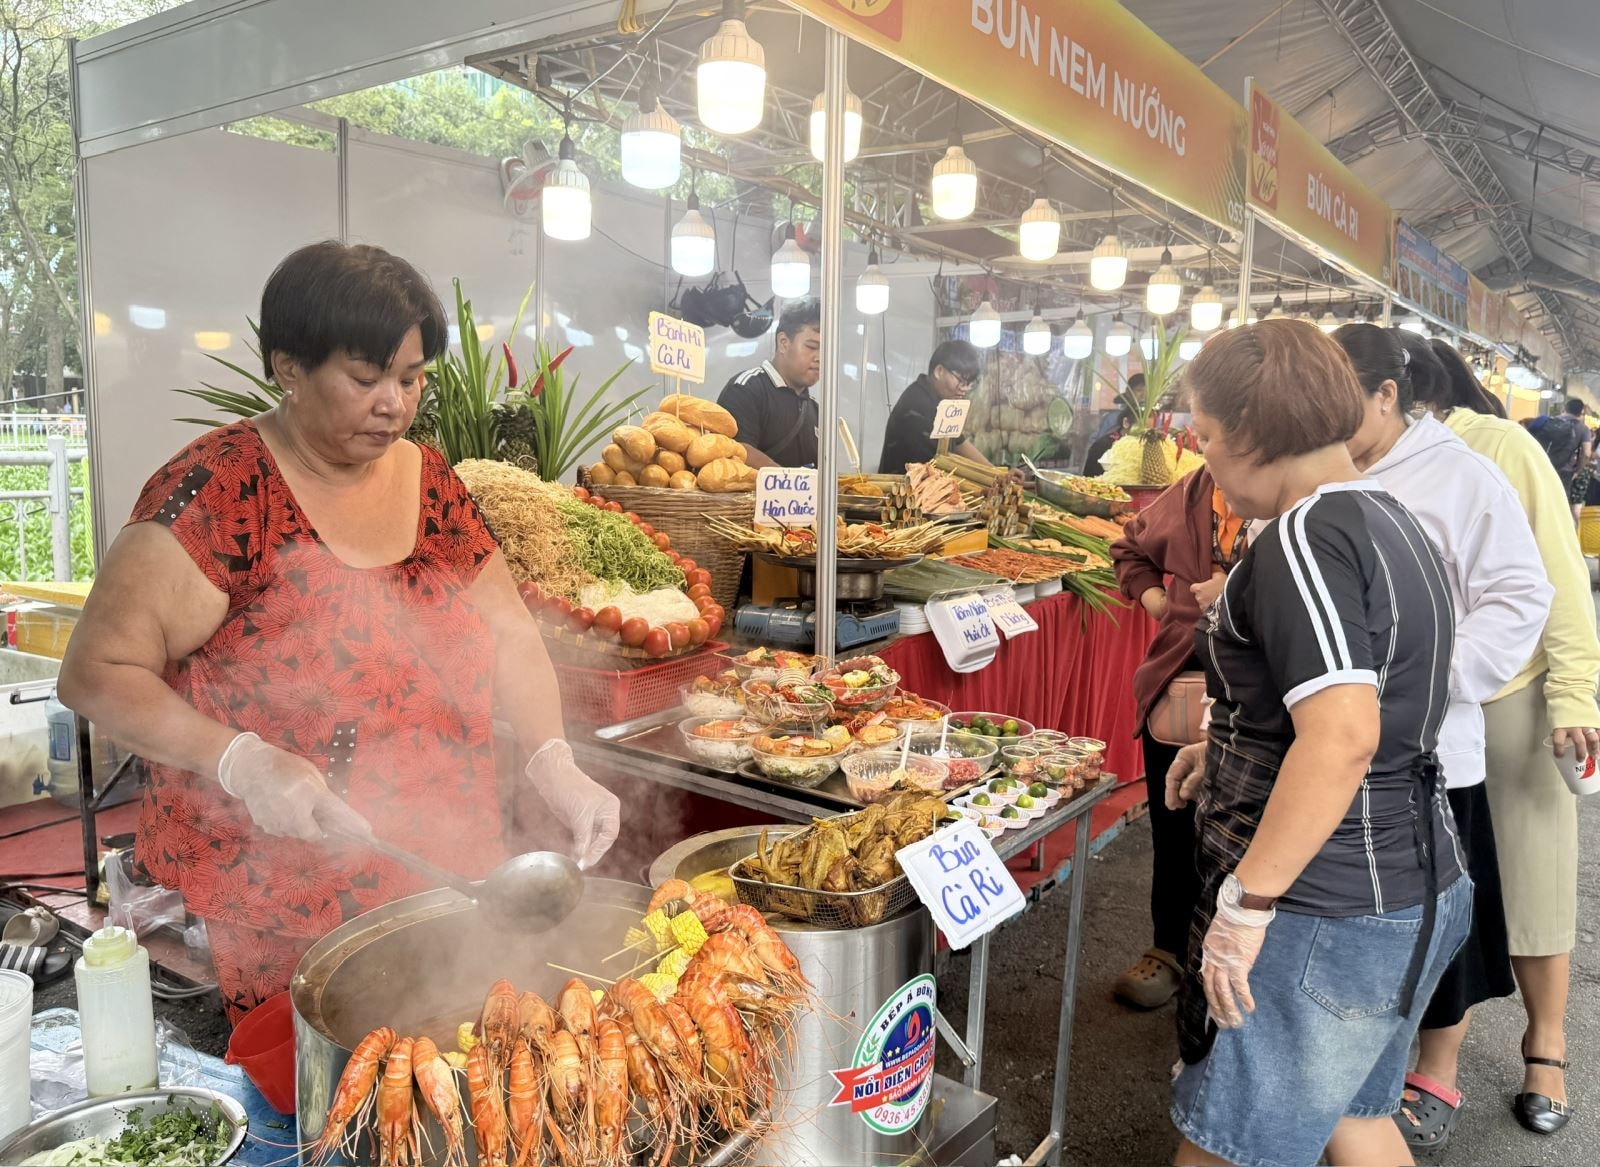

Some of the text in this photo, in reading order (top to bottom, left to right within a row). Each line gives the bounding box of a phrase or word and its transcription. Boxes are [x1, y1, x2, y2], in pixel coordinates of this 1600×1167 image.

[1048, 27, 1105, 108] NEM
[1113, 71, 1186, 156] NƯỚNG
[1307, 173, 1332, 222] BÚN
[1333, 191, 1347, 235] CÀ
[1349, 206, 1359, 241] RI
[657, 317, 687, 343] Bánh
[658, 343, 675, 366] Cà
[937, 418, 959, 434] Lam
[764, 473, 810, 491] Chả Cá
[762, 495, 815, 516] Hàn Quốc
[929, 834, 980, 873] Bún
[942, 867, 1004, 924] Cà Ri
[880, 1001, 903, 1031] BẾP
[907, 989, 913, 1004] Á
[854, 1076, 880, 1098] NỒI
[884, 1066, 911, 1089] ĐIỆN
[914, 1050, 929, 1072] CAO
